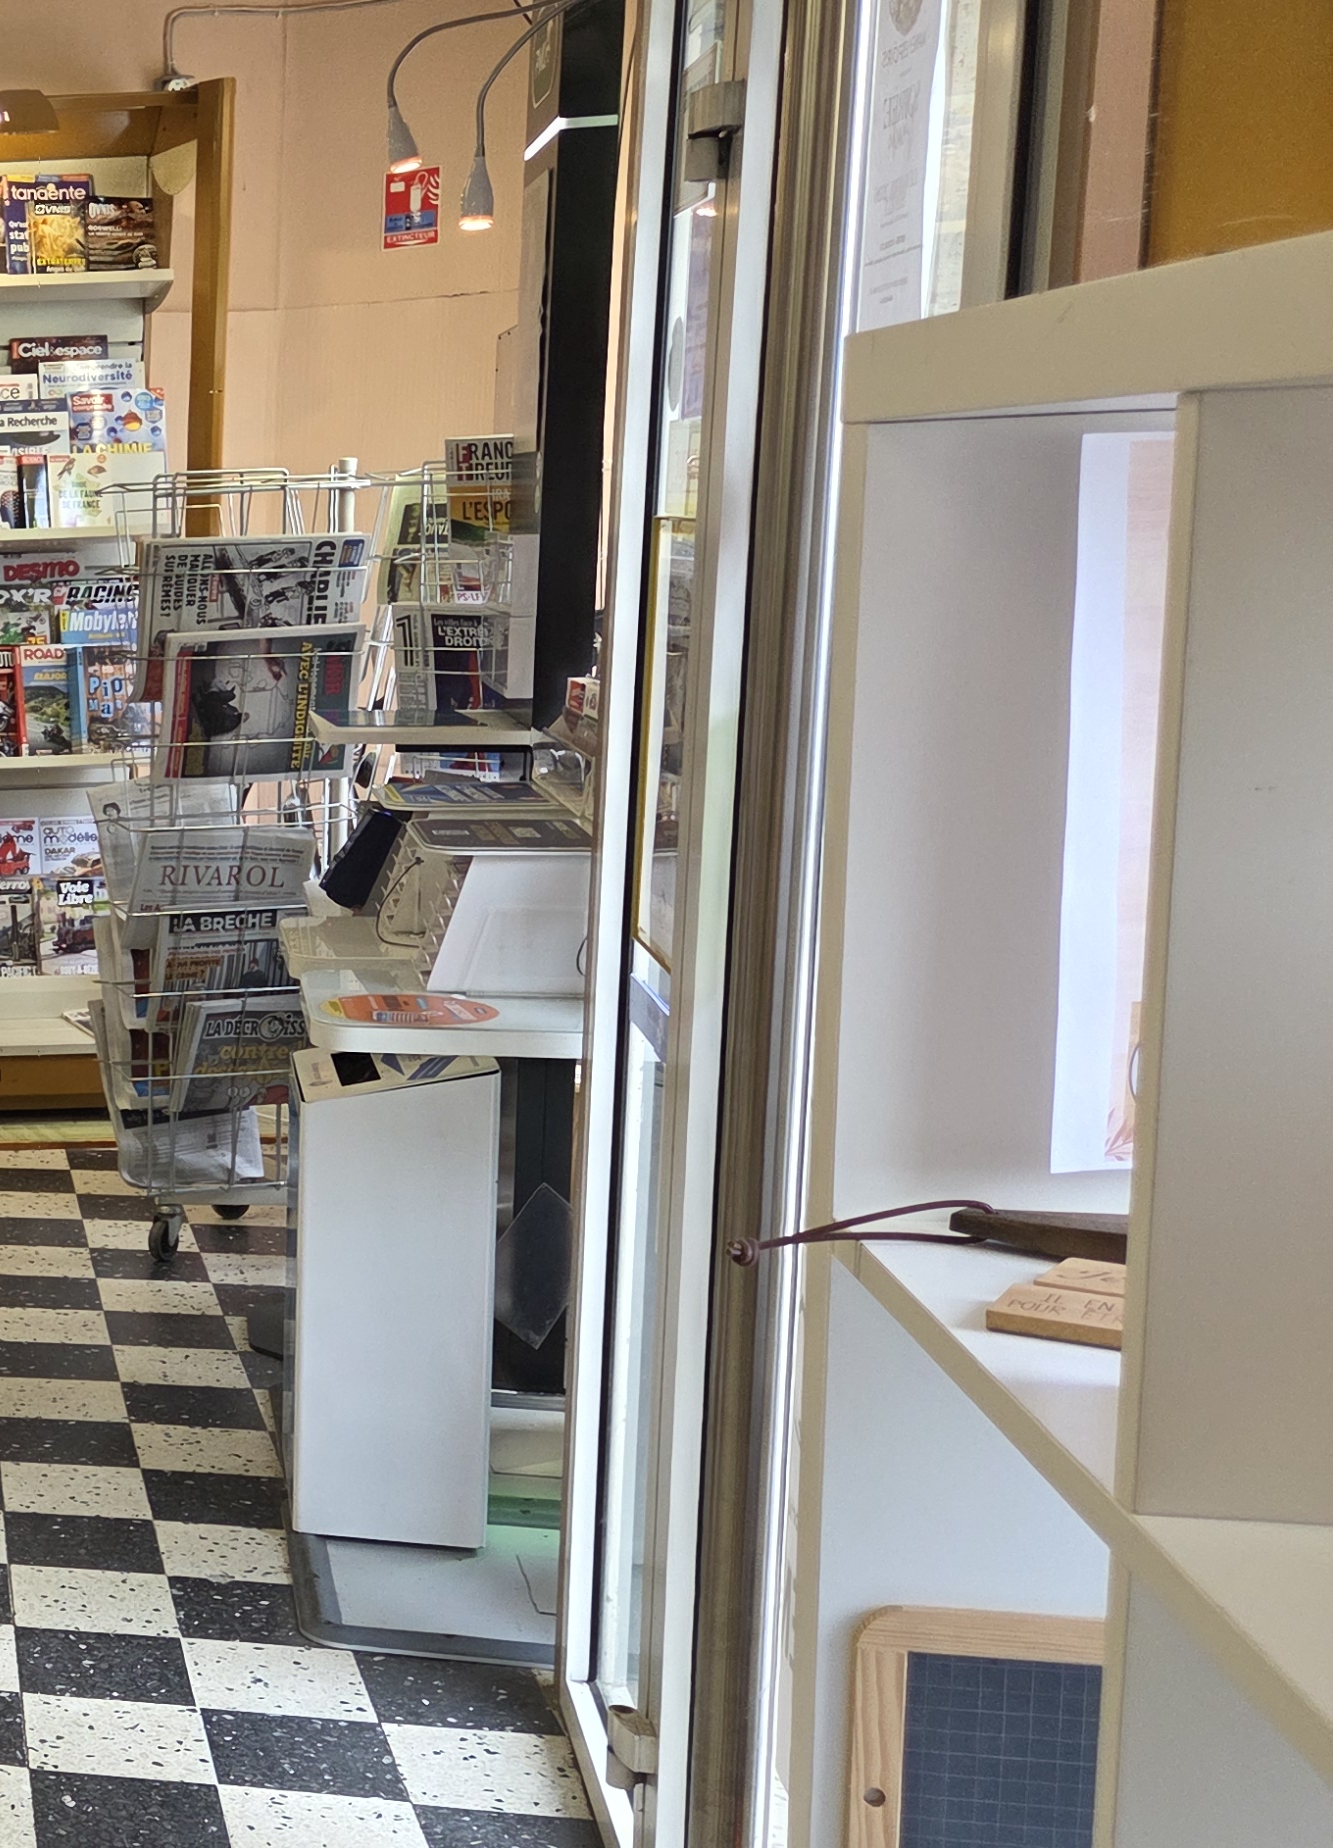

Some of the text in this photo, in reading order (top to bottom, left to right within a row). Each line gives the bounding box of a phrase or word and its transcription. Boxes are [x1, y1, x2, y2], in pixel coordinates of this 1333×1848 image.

[10, 182, 87, 202] tangente
[386, 230, 436, 244] EXTINCTEUR
[55, 343, 103, 357] espace
[42, 371, 133, 384] Neurodiversité
[8, 415, 58, 428] Recherche
[3, 559, 80, 583] DESMO
[23, 648, 65, 661] ROAD
[160, 864, 285, 888] RIVAROL
[59, 881, 90, 895] Voie
[58, 893, 94, 906] Libre
[204, 1021, 223, 1037] LA
